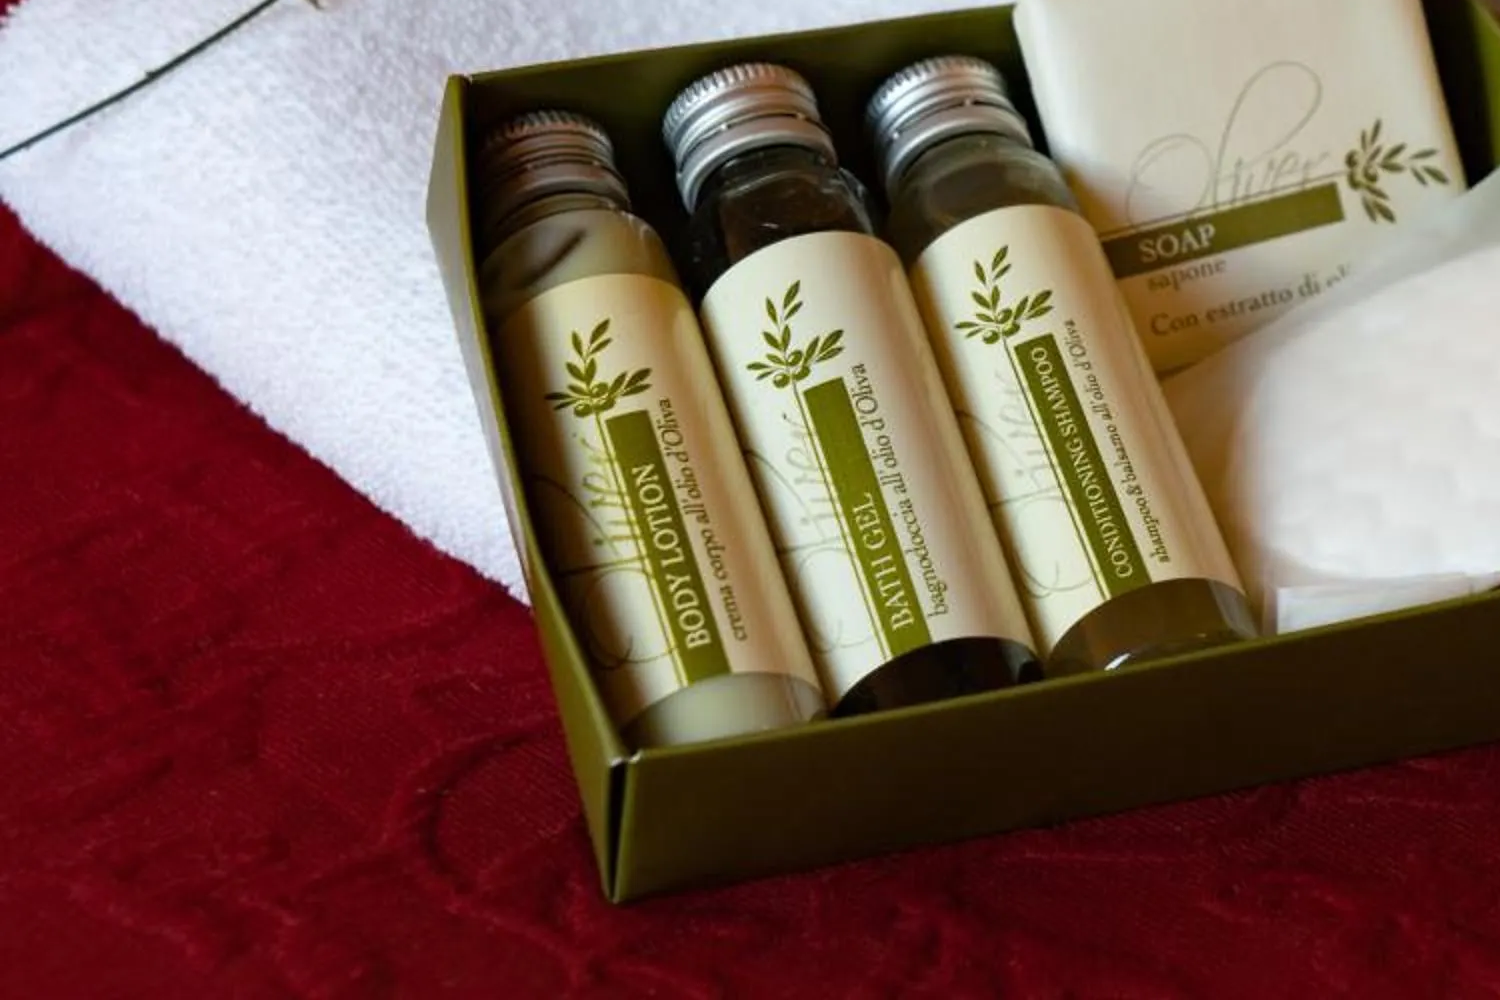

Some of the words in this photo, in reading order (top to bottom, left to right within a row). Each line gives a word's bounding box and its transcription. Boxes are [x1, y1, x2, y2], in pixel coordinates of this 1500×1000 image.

[1138, 224, 1216, 263] SOAP
[1147, 259, 1226, 291] sapone
[1150, 312, 1199, 336] Con
[1205, 287, 1293, 324] estratto
[1298, 272, 1321, 298] di
[851, 363, 885, 431] d'Oliva
[1031, 347, 1078, 438] SHAMPOO
[656, 398, 689, 462] d'Oliva
[1107, 424, 1137, 484] balsamo
[632, 464, 684, 567] LOTION
[852, 493, 886, 550] GEL
[1065, 438, 1133, 578] CONDITIONING
[1135, 497, 1170, 563] shampoo
[701, 529, 727, 581] corpo
[893, 499, 949, 617] bagnodoccia
[666, 574, 711, 649] BODY
[720, 585, 747, 641] crema
[871, 554, 914, 631] BATH
